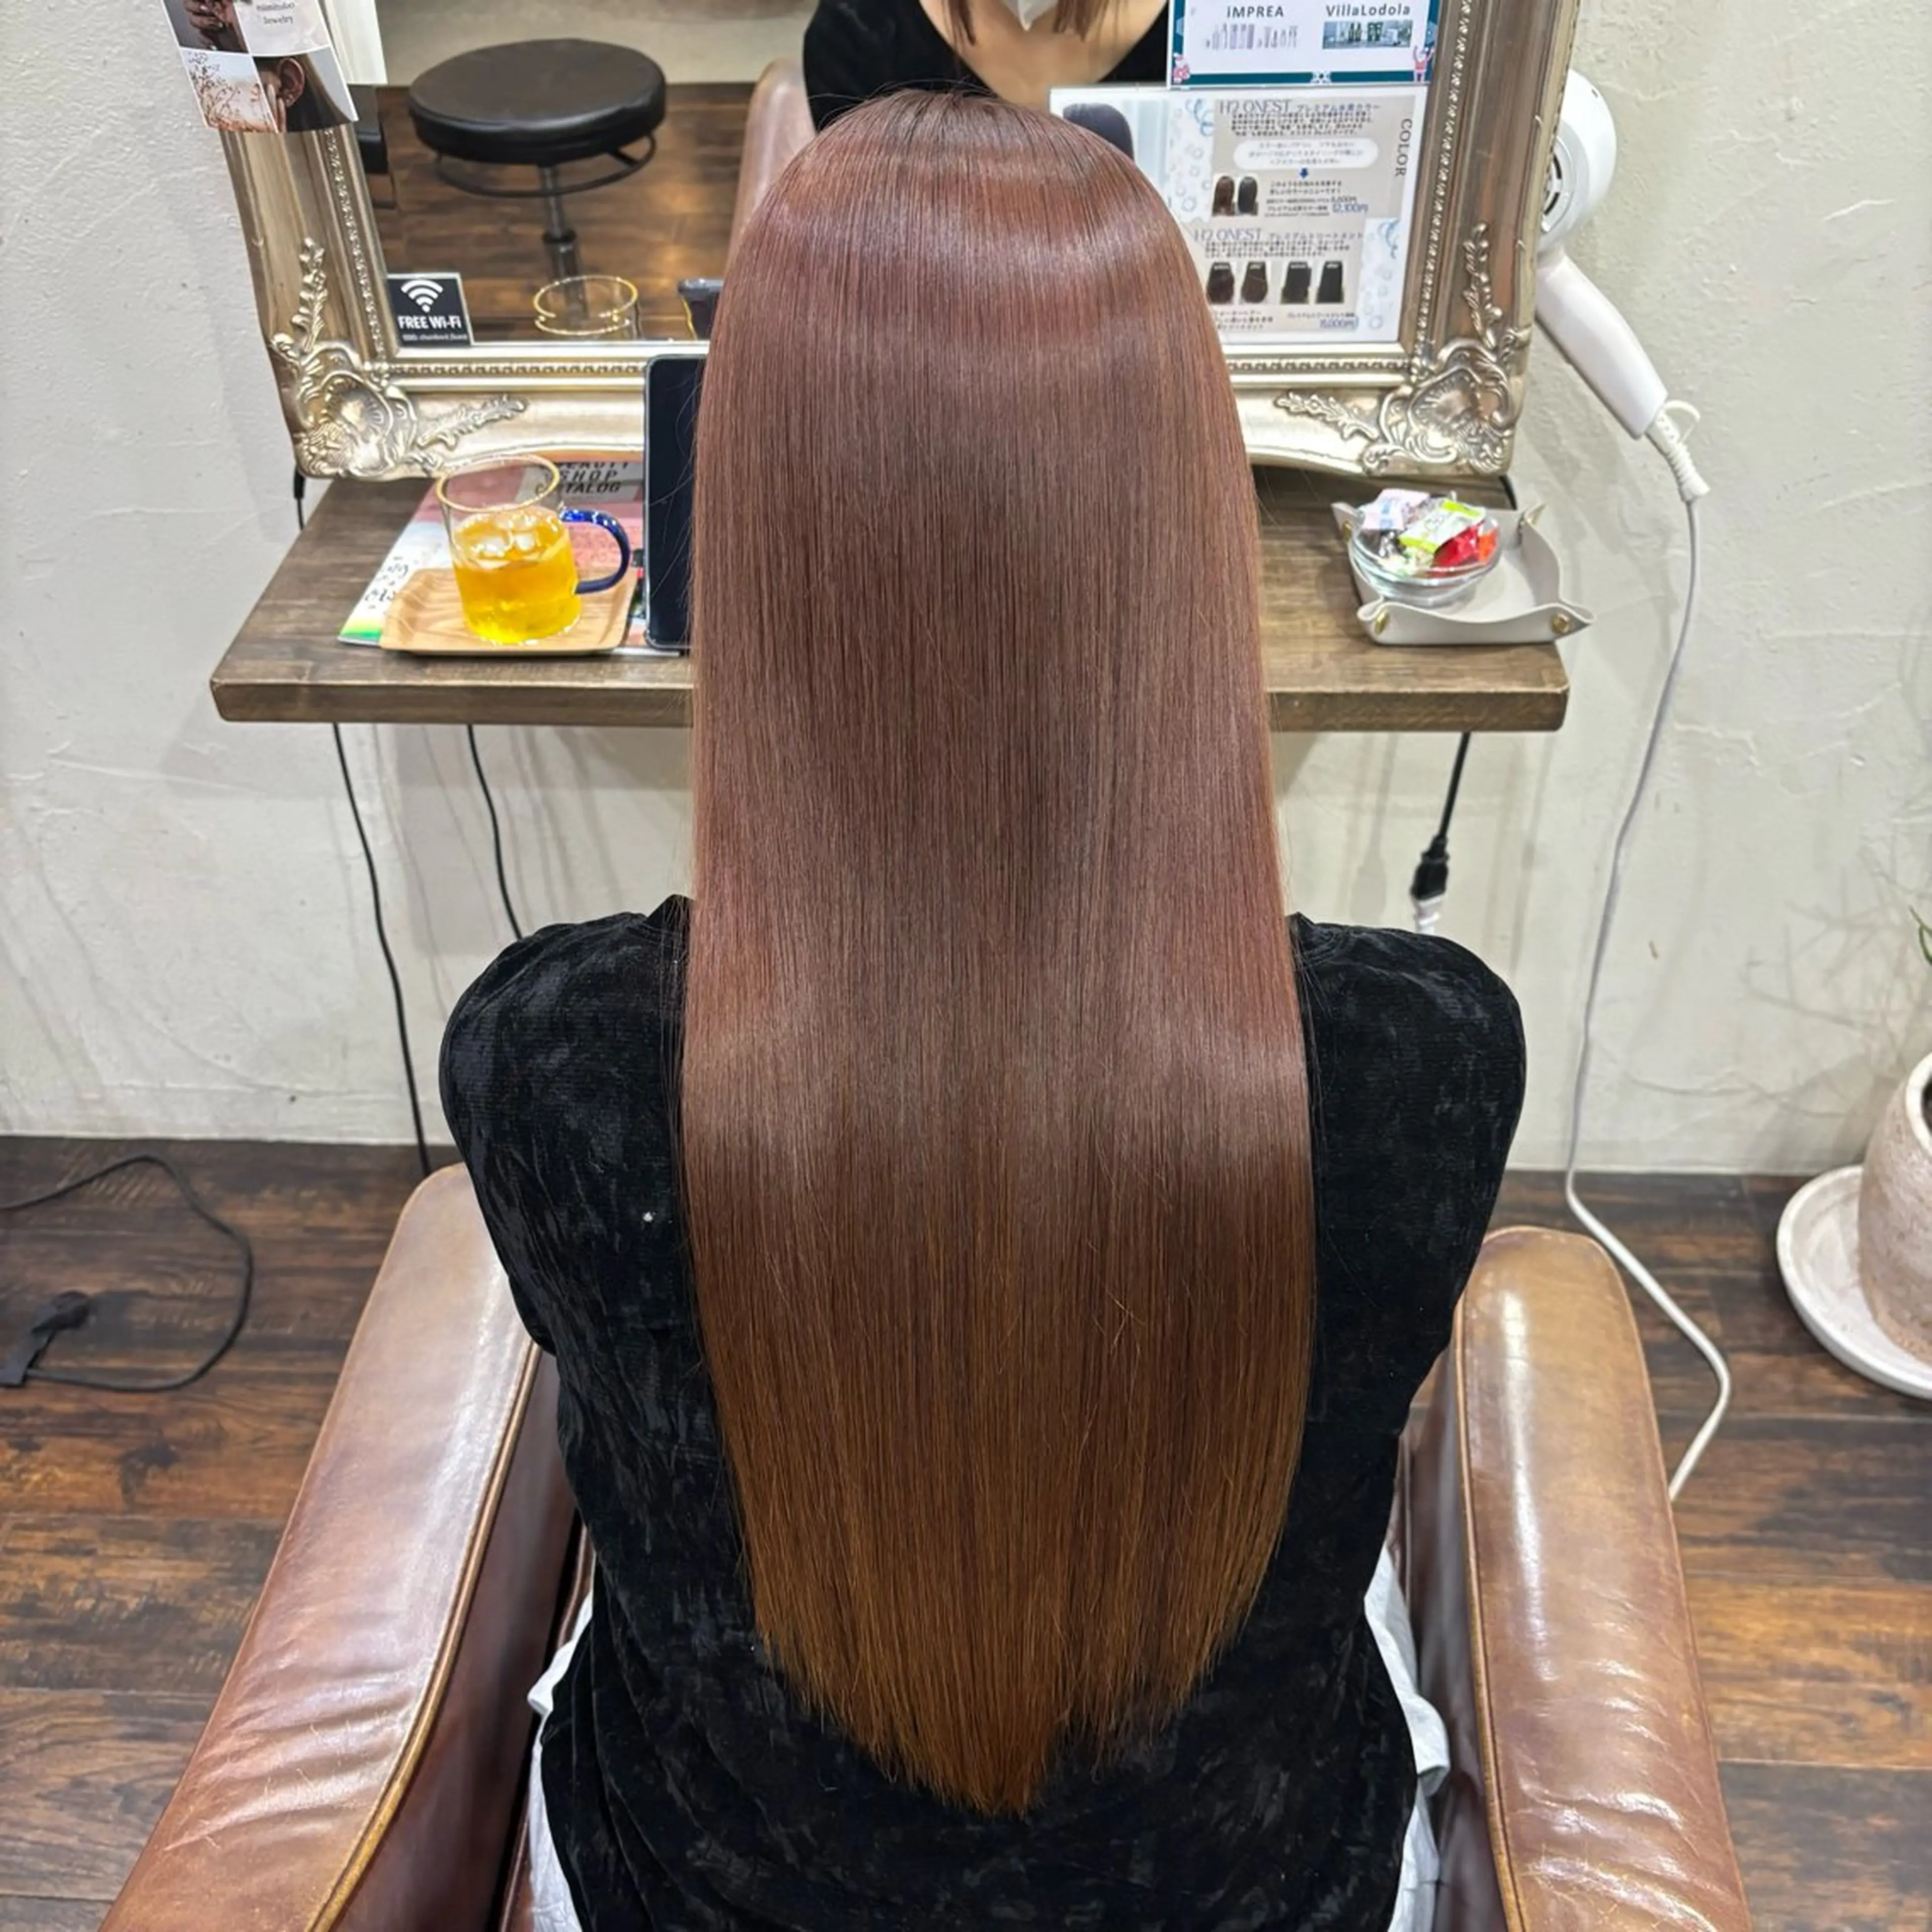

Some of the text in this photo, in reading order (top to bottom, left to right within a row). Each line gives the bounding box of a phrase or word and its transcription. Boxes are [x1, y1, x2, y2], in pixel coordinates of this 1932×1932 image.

[1227, 6, 1284, 18] IMPREA
[1326, 4, 1411, 17] VillaLodola
[1395, 118, 1413, 177] COLOR
[397, 315, 428, 329] FREE
[560, 469, 618, 482] SHOP
